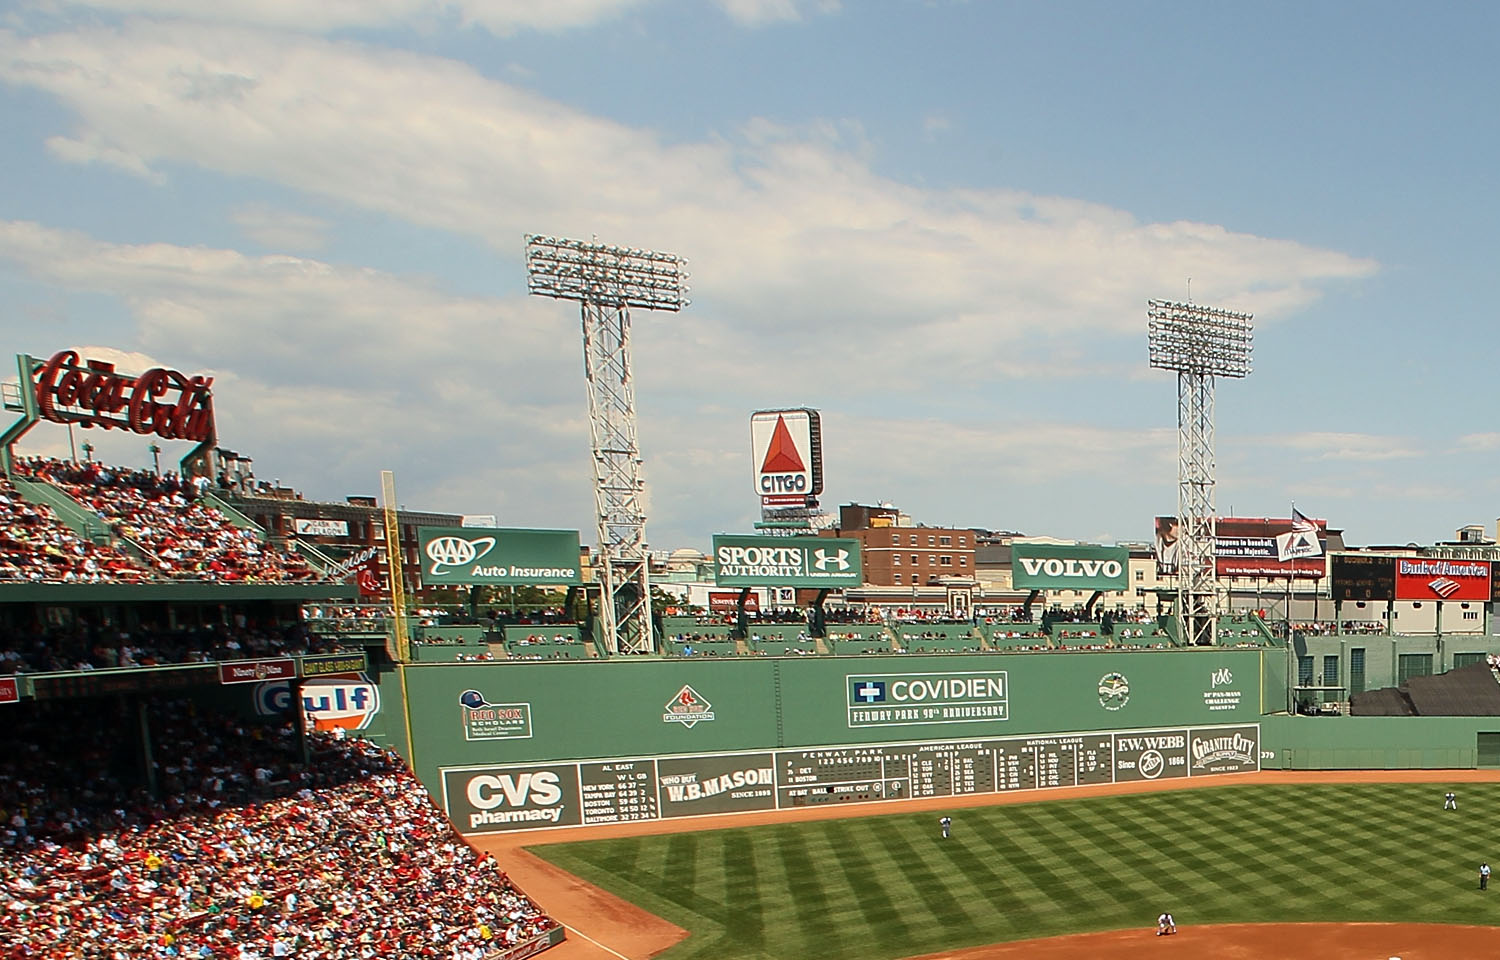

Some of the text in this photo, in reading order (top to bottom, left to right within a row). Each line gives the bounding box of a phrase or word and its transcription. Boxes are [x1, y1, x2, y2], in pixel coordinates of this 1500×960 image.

[761, 475, 806, 493] CITGO
[430, 539, 471, 564] AAA
[718, 547, 803, 566] SPORTS
[472, 565, 575, 578] Auto Insurance
[1020, 557, 1122, 579] VOLVO
[1400, 560, 1428, 576] Bank
[1428, 561, 1442, 576] of
[1443, 561, 1488, 577] America
[891, 678, 1003, 701] COVIDIEN
[470, 708, 523, 720] RED SOX
[853, 705, 1004, 722] FENWAY PARK 98th ANNIVERSARY
[919, 744, 955, 752] AMERICAN
[1145, 735, 1185, 750] WEBB
[803, 748, 883, 759] FENWAY PARK
[1261, 751, 1275, 759] 379
[615, 763, 634, 771] EAST
[1118, 760, 1136, 769] Since
[661, 774, 697, 785] WHO BUT
[466, 771, 562, 810] CVS
[731, 790, 753, 799] SINCE
[584, 800, 611, 808] BOSTON
[470, 806, 562, 828] pharmacy
